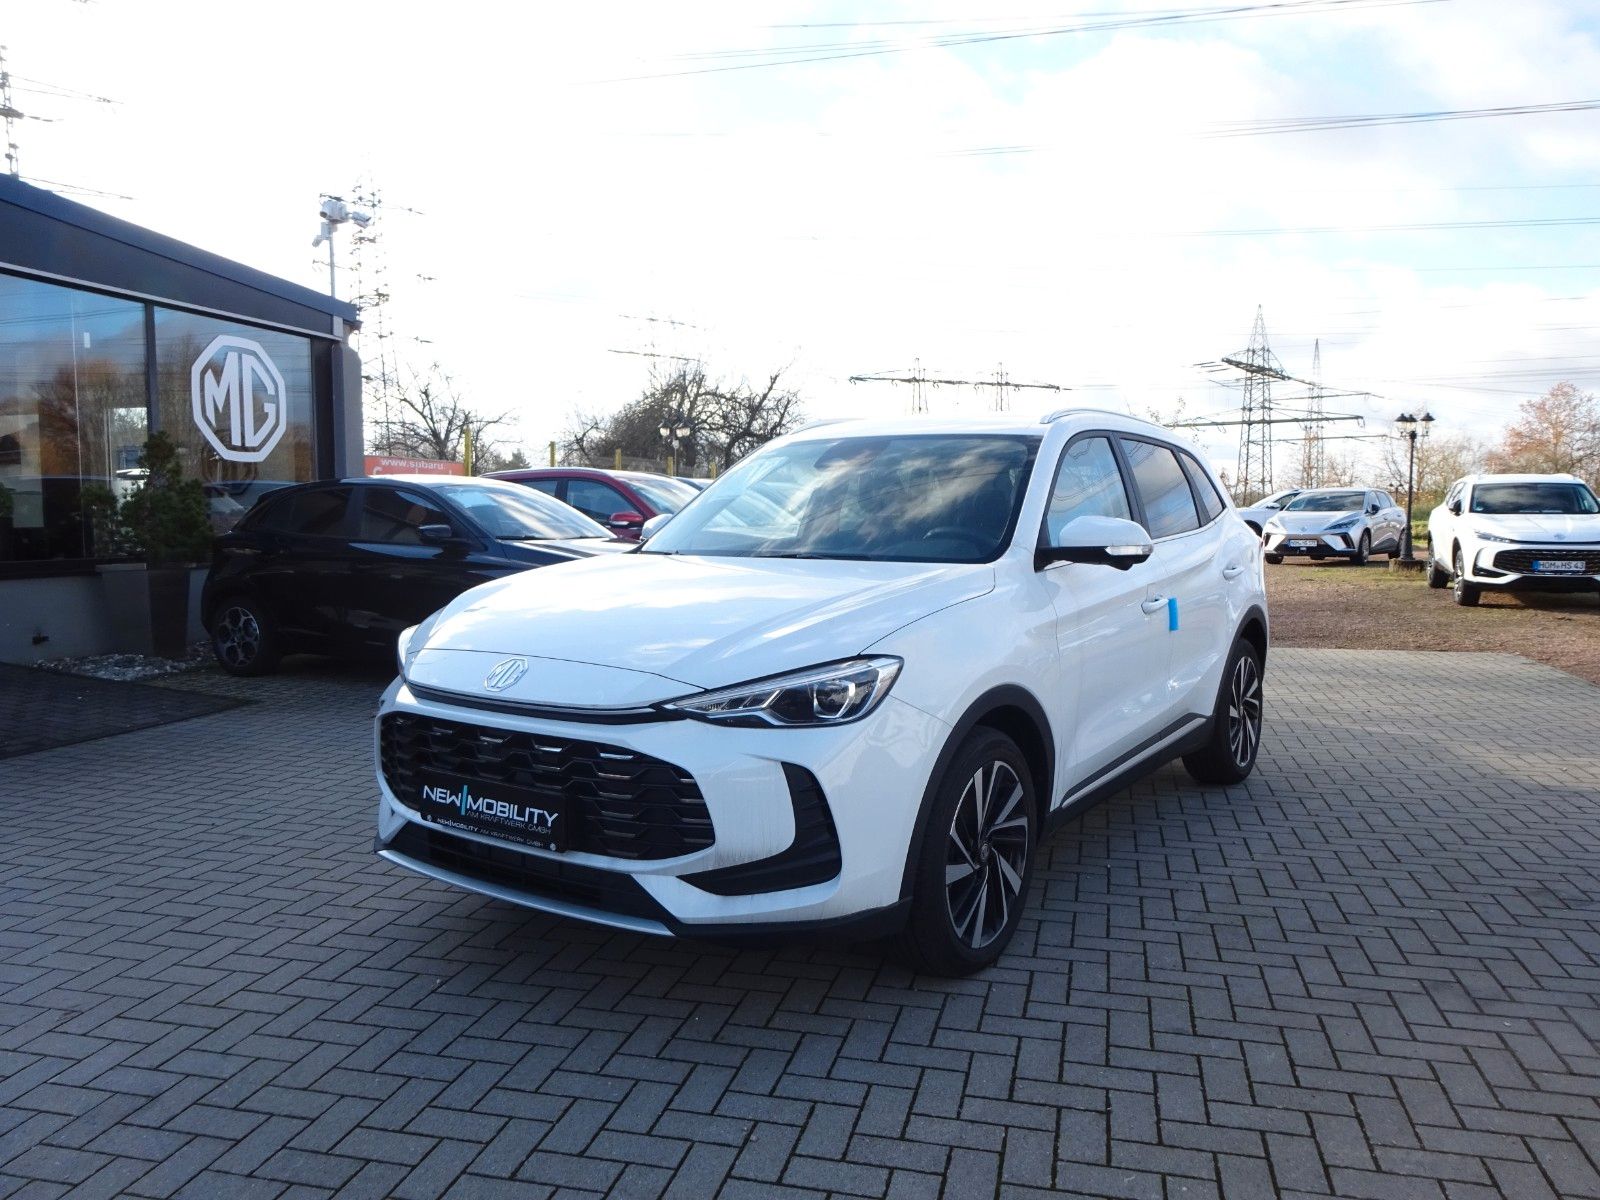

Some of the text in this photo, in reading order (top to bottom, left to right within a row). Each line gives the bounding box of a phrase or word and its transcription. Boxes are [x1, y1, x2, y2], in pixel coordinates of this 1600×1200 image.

[204, 351, 276, 447] MG
[488, 659, 525, 689] MG
[480, 814, 526, 829] KRAFTWERK
